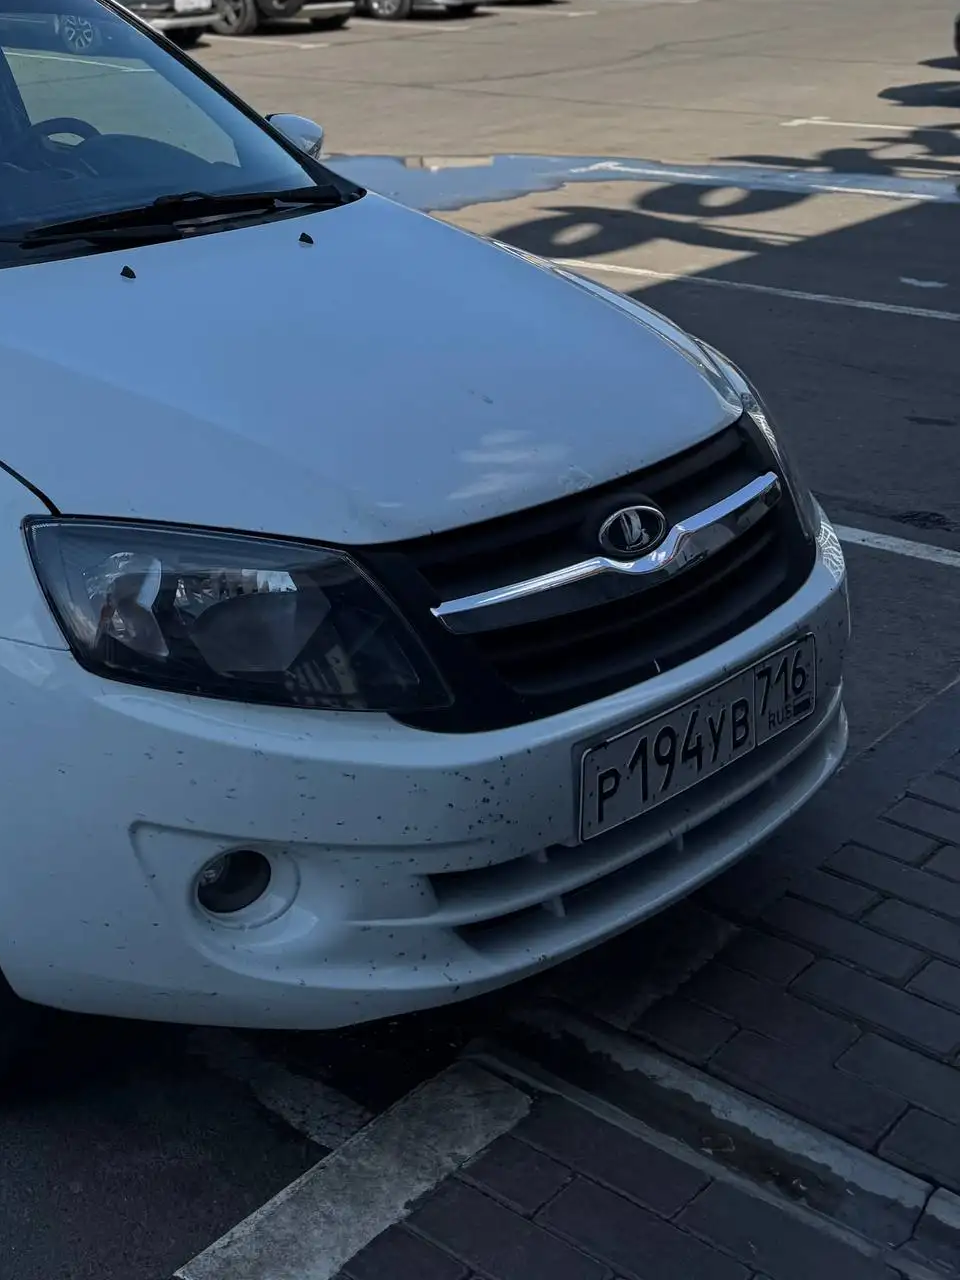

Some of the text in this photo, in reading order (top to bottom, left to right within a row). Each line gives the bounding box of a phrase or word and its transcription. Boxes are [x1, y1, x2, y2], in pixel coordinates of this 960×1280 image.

[597, 649, 807, 823] Р194УВ 716
[768, 703, 792, 730] RUS
